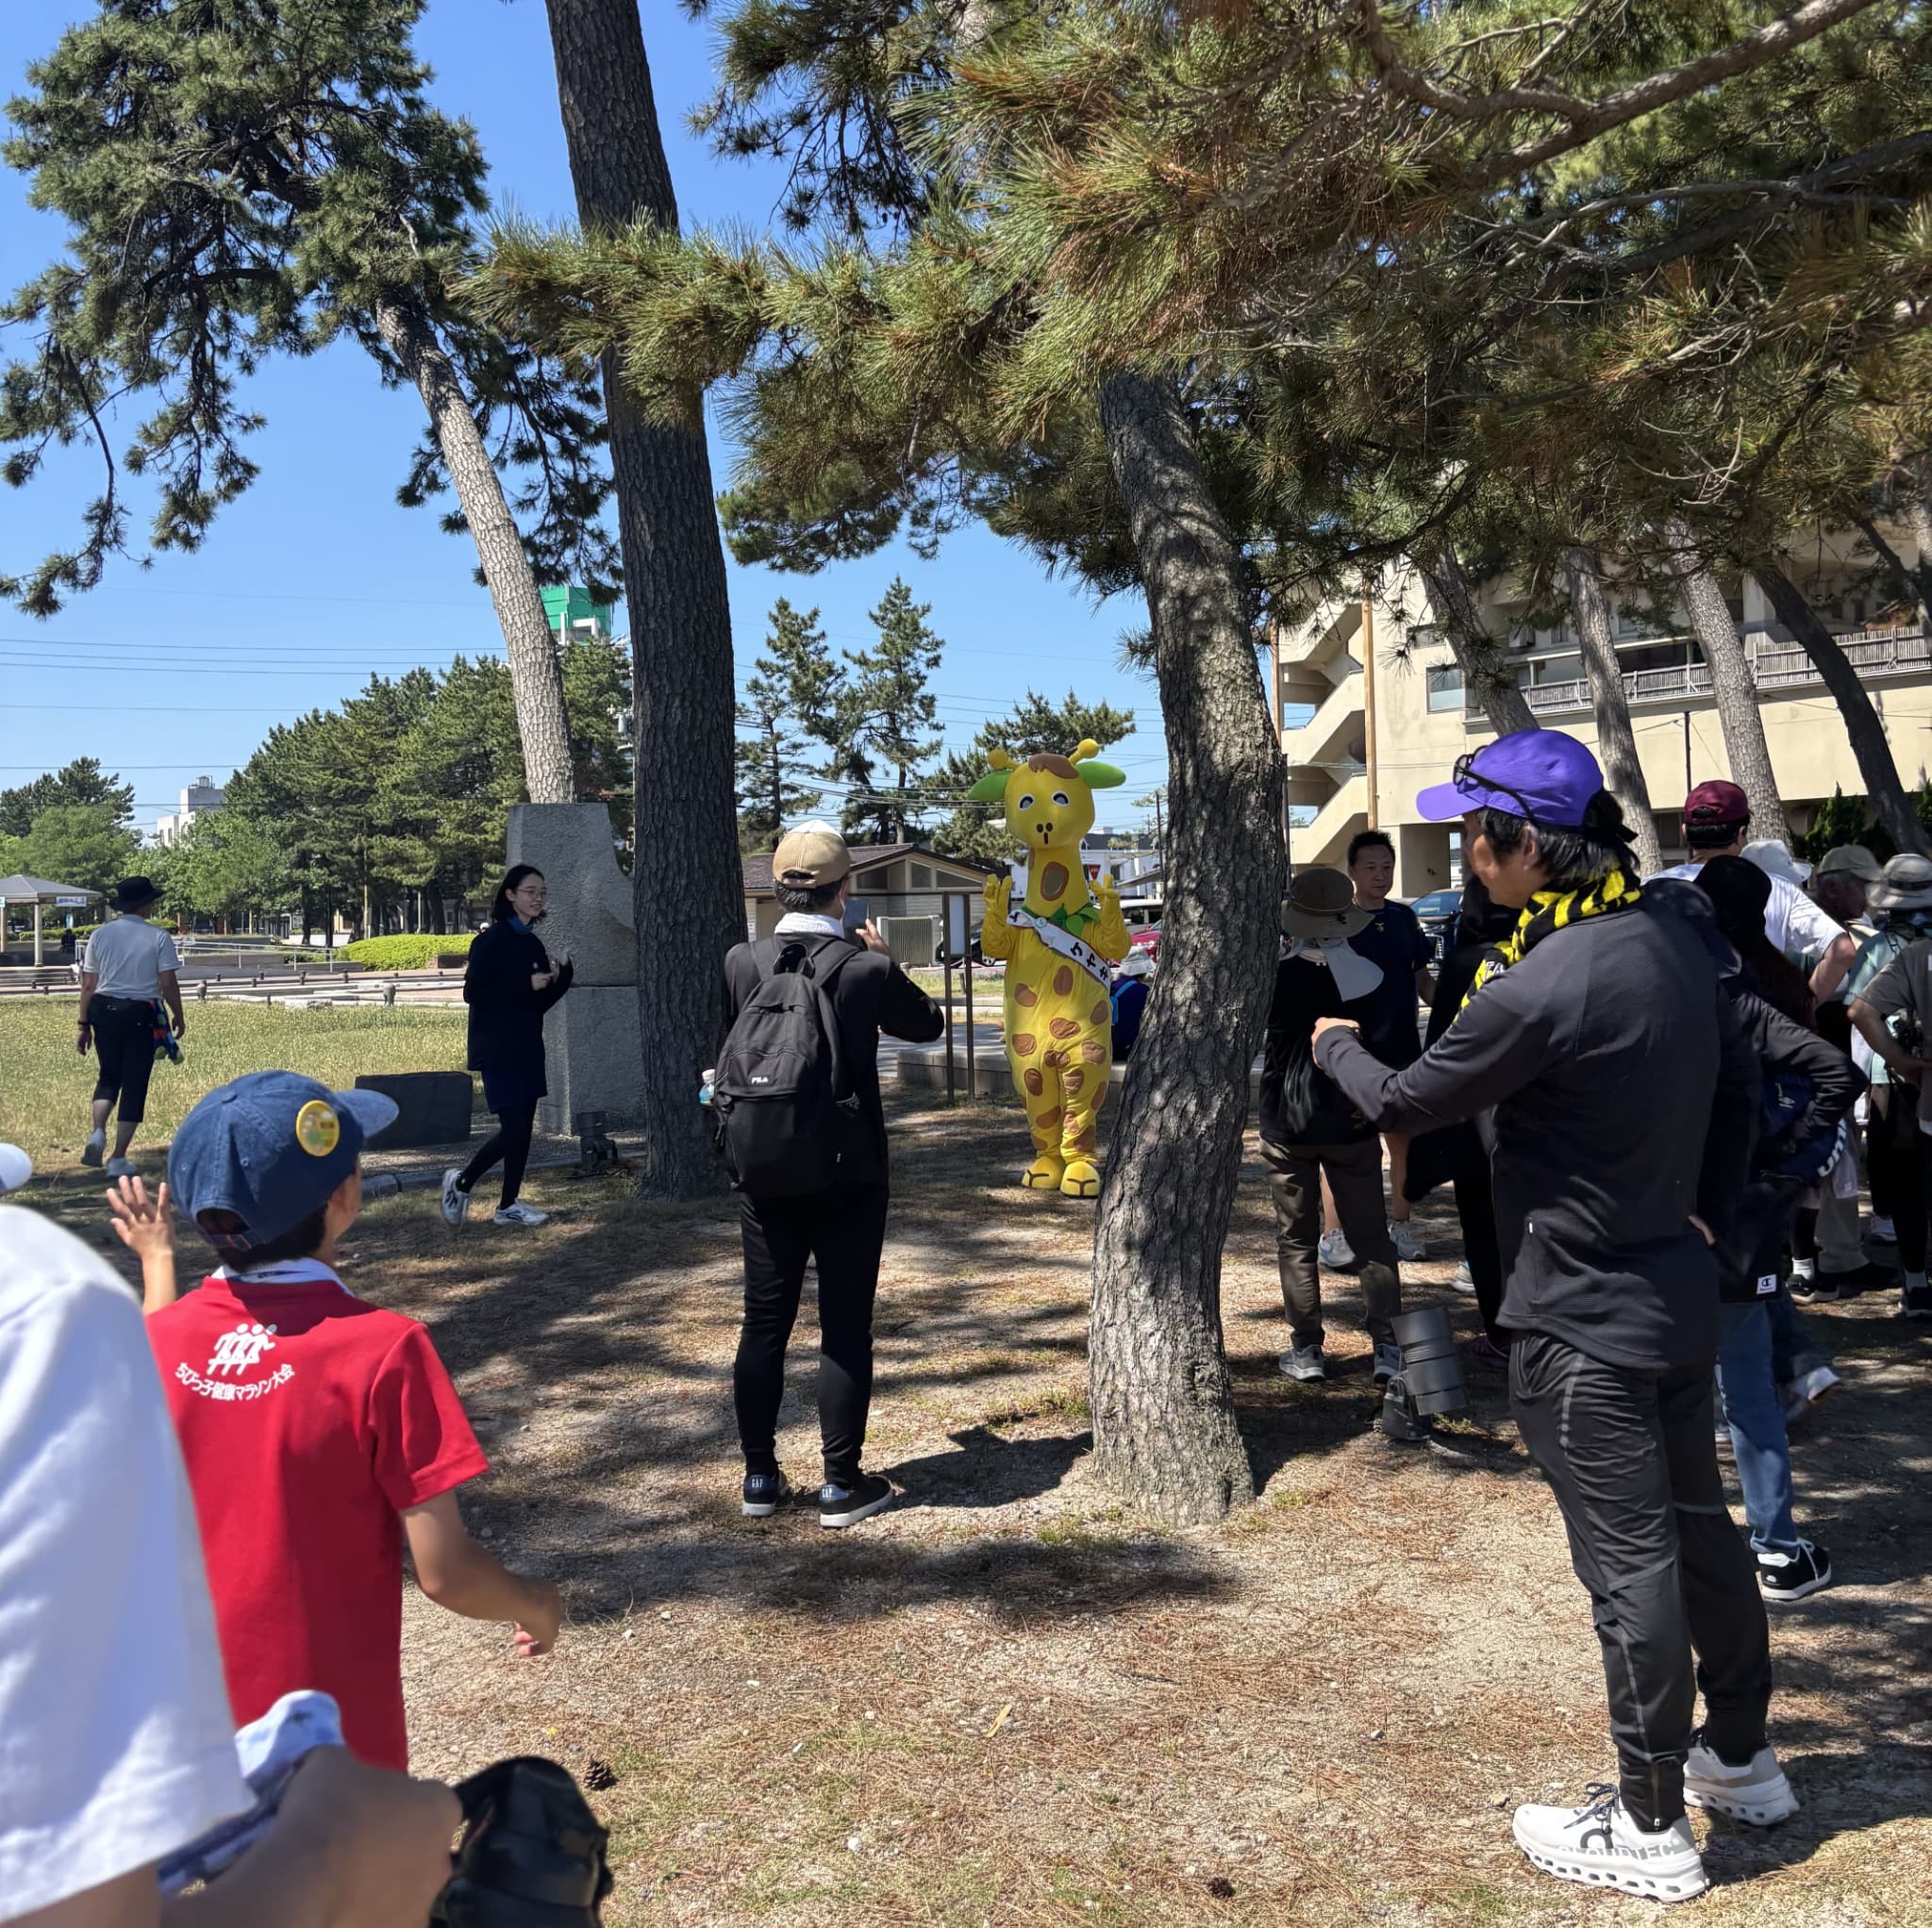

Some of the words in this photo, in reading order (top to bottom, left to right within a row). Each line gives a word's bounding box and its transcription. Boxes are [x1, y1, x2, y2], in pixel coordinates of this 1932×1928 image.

[175, 1362, 295, 1402] ちびっ子健康マラソン大会
